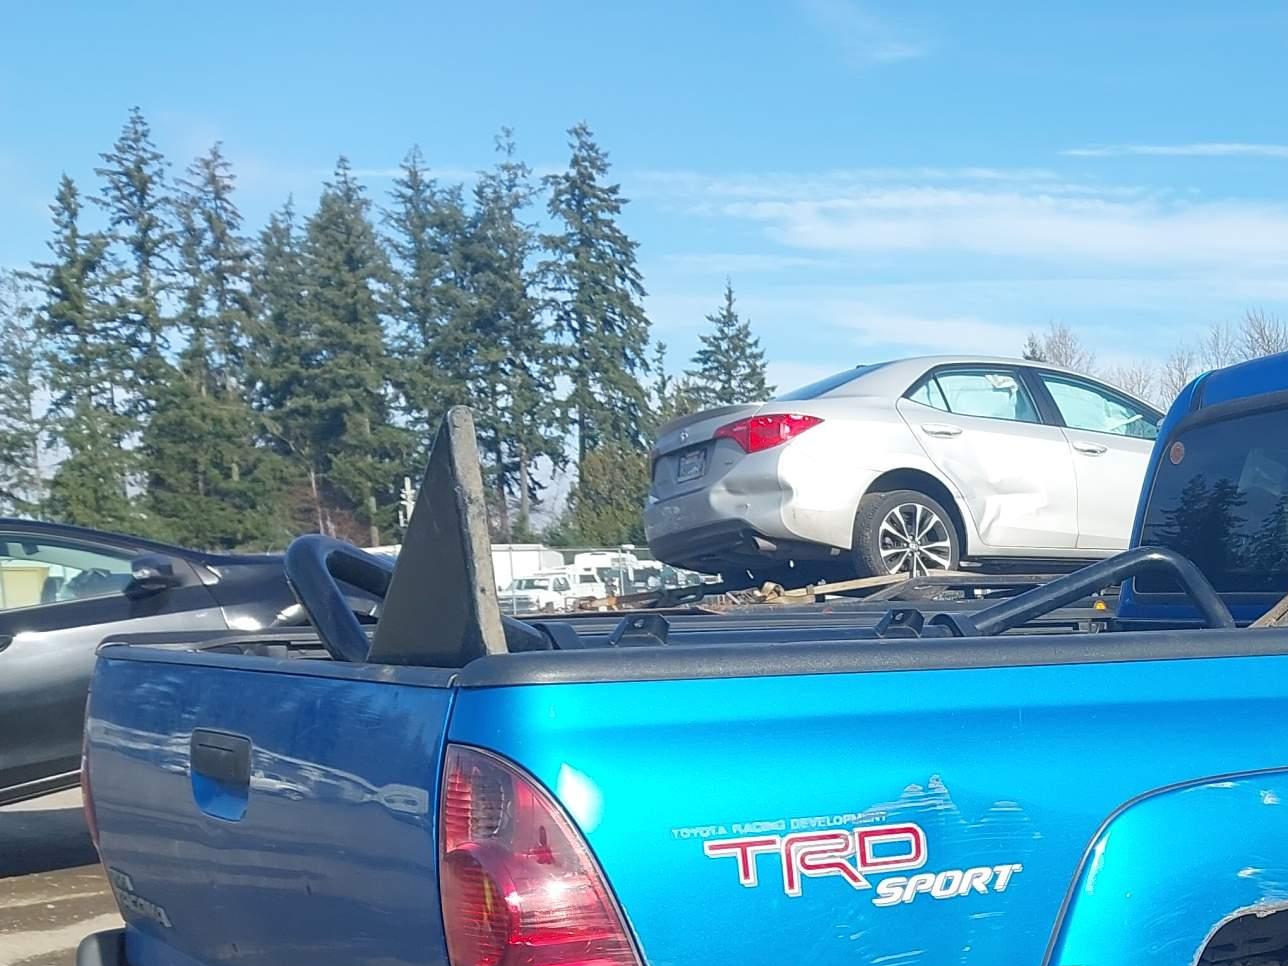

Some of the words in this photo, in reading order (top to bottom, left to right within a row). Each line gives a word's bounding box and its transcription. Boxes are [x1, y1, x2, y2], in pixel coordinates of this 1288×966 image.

[671, 826, 728, 839] TOYOTA
[732, 820, 786, 835] RACING
[791, 812, 887, 831] DEVELOPMENT
[704, 822, 928, 898] TRD
[872, 863, 1024, 907] SPORT
